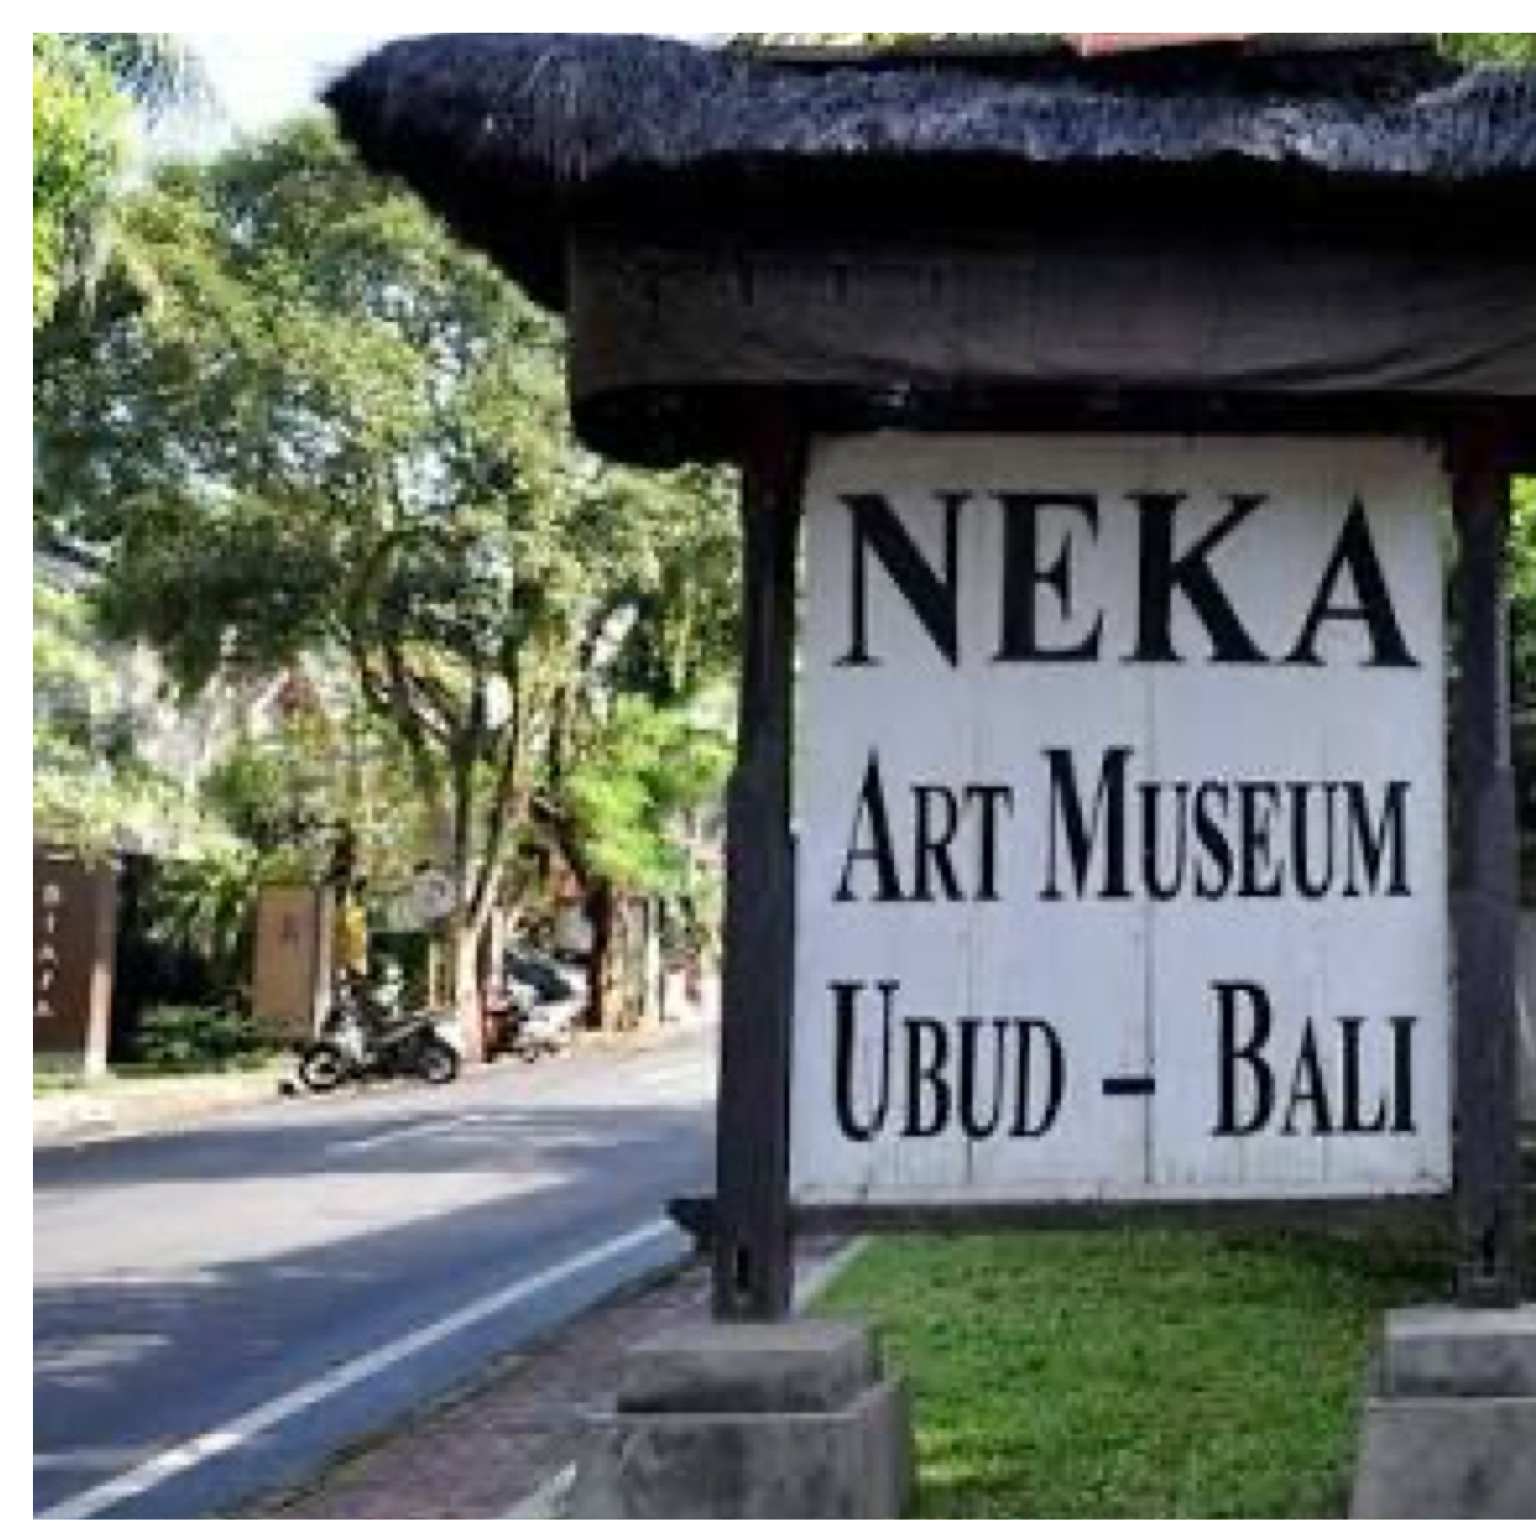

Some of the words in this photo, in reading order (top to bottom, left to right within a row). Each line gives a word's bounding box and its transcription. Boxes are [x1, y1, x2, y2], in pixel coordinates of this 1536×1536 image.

[831, 491, 1421, 668] NEKA
[834, 744, 1014, 903] ART
[1039, 744, 1412, 903] MUSEUM
[827, 979, 1067, 1143] UBUD
[1211, 979, 1418, 1138] BALI
